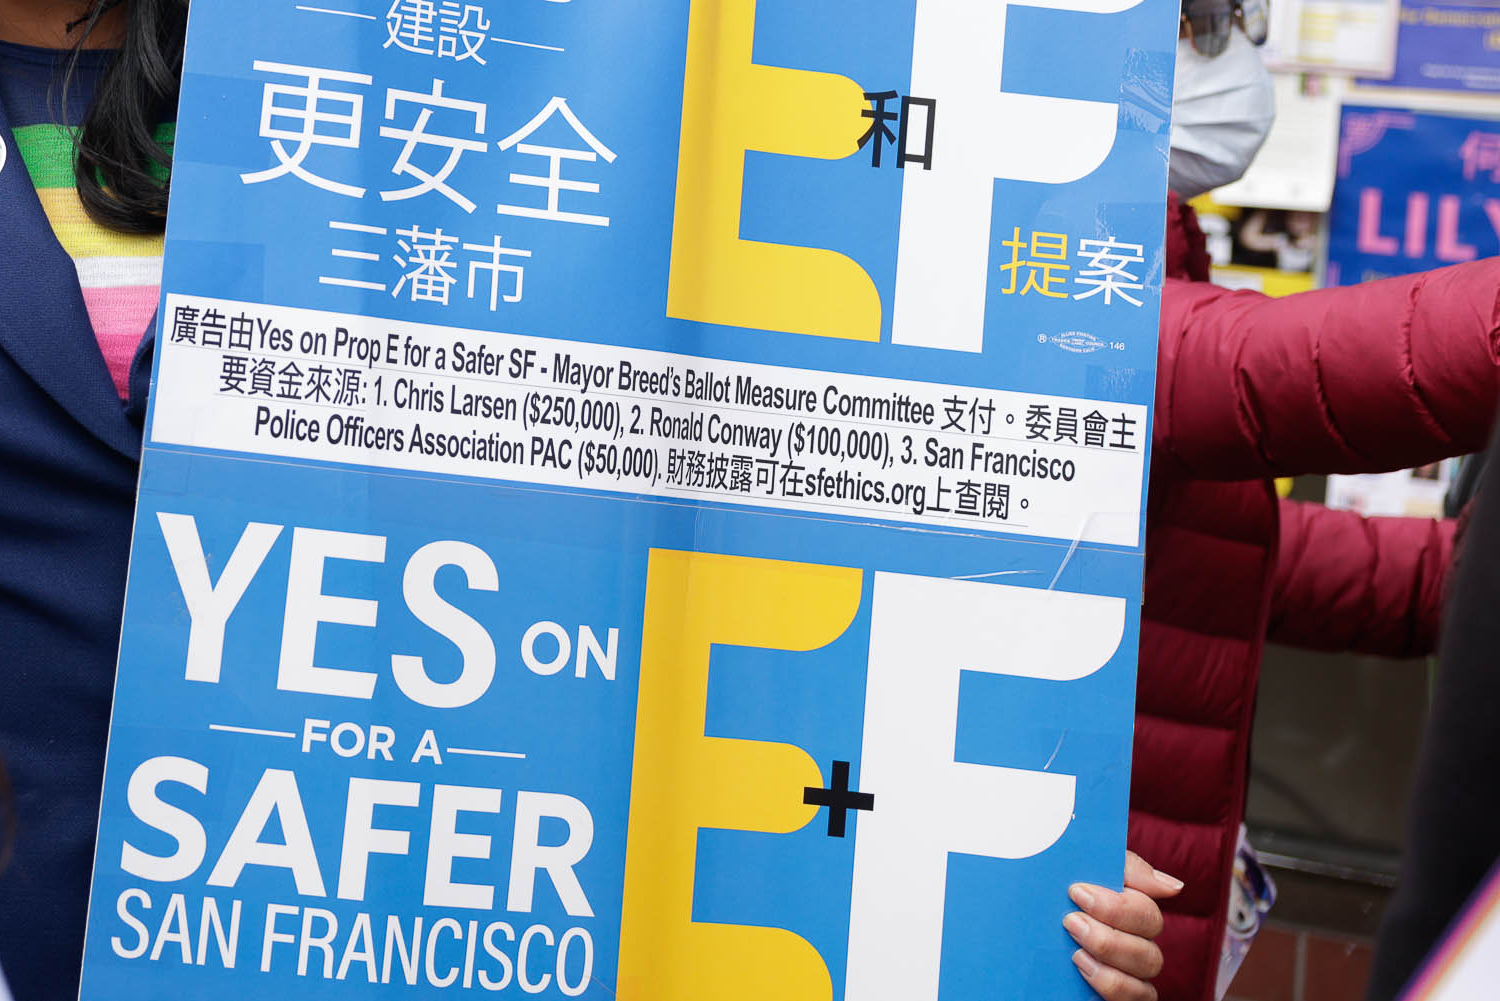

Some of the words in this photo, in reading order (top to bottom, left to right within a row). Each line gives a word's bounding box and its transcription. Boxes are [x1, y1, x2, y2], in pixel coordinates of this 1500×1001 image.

[240, 59, 618, 228] 更安全
[857, 88, 937, 172] 和
[318, 220, 533, 313] 三藩市
[999, 226, 1146, 308] 提案
[300, 329, 327, 354] on
[333, 326, 381, 369] Prop
[386, 333, 400, 365] E
[404, 334, 431, 368] for
[435, 346, 447, 371] a
[451, 341, 505, 377] Safer
[508, 348, 537, 380] SF
[553, 352, 615, 394] Mayor
[618, 360, 681, 398] Breed's
[684, 369, 731, 402] Ballot
[735, 375, 817, 413] Measure
[823, 385, 935, 425] Committee
[254, 405, 320, 443] Police
[326, 413, 405, 453] Officers
[408, 423, 525, 466] Association
[530, 436, 573, 470] PAC
[578, 440, 662, 488] ($50,000).
[374, 375, 388, 407] 1.
[393, 377, 445, 413] Chris
[450, 385, 517, 421] Larsen
[523, 391, 624, 440] ($250,000),
[629, 404, 644, 435] 2.
[649, 406, 703, 442] Ronald
[707, 413, 783, 458] Conway
[787, 422, 894, 470] ($100,000),
[900, 434, 918, 466] 3.
[924, 437, 964, 470] San
[970, 442, 1076, 483] Francisco
[157, 511, 500, 710] YES
[520, 620, 619, 682] ON
[300, 717, 395, 763] FOR
[410, 729, 443, 766] A
[614, 546, 864, 1001] E
[844, 569, 1127, 1001] F
[120, 755, 598, 919] SAFER
[110, 887, 260, 973] SAN
[262, 902, 596, 998] FRANCISCO
